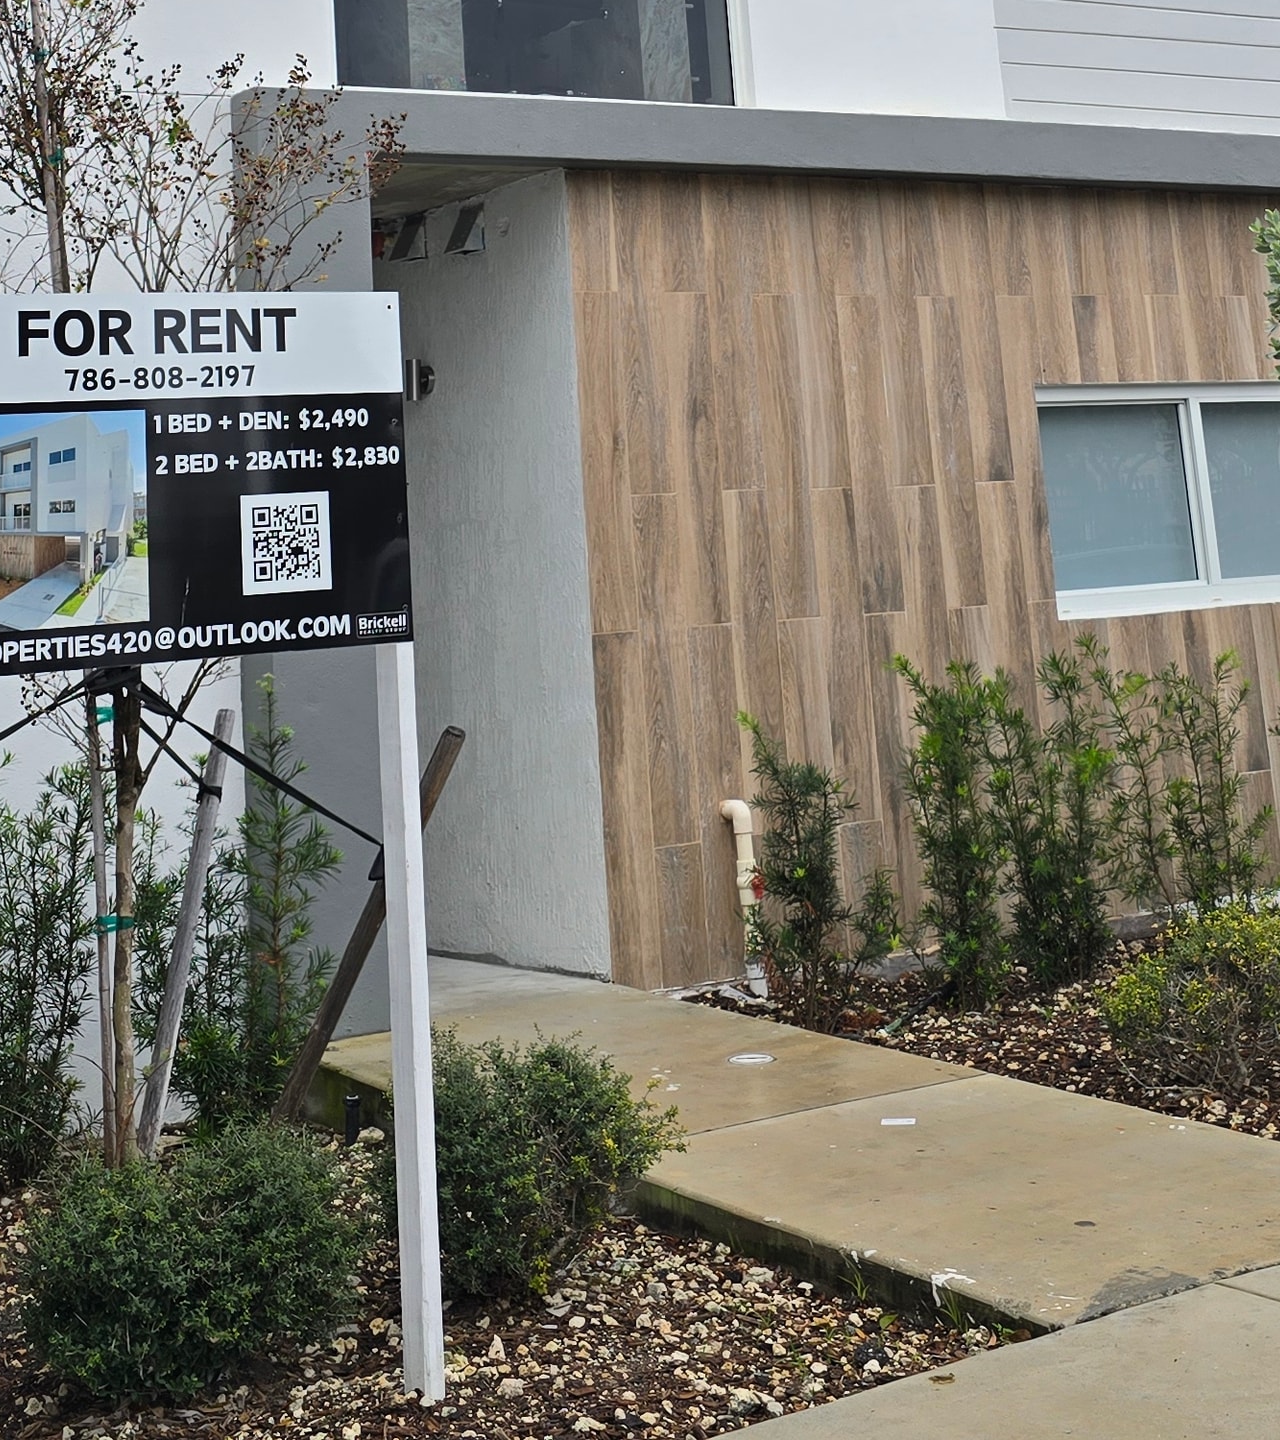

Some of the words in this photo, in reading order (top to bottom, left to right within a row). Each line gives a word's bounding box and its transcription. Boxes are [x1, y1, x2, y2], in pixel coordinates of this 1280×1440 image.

[18, 309, 134, 357] FOR
[154, 307, 297, 354] RENT
[64, 364, 255, 392] 786-808-2197
[153, 415, 162, 434] 1
[168, 413, 212, 434] BED
[218, 415, 232, 430] +
[239, 410, 290, 431] DEN:
[299, 408, 369, 431] $2,490
[155, 456, 168, 475] 2
[175, 453, 218, 474] BED
[225, 455, 239, 470] +
[246, 449, 323, 471] 2BATH:
[332, 445, 400, 469] $2,830
[359, 614, 407, 630] Brickell
